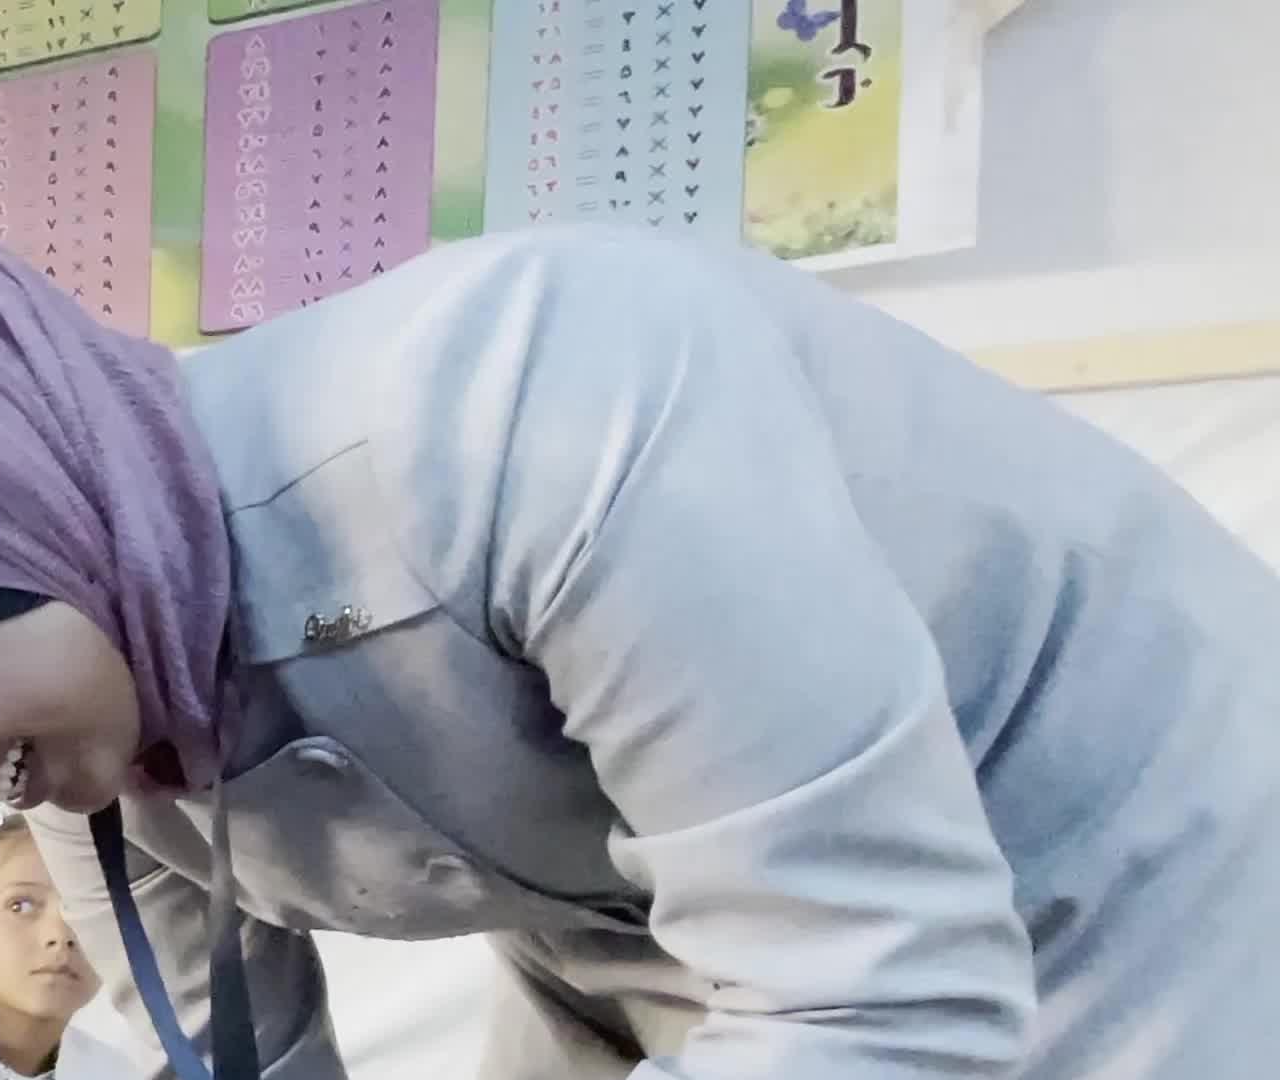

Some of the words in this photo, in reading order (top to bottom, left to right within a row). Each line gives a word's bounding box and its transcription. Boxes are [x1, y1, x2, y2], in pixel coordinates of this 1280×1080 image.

[621, 10, 636, 26] ٣
[690, 24, 707, 39] ٧
[621, 38, 632, 53] ٤
[690, 49, 706, 64] ٧
[619, 64, 632, 80] ٥
[689, 77, 704, 91] ٧
[617, 90, 632, 105] ٦
[688, 104, 704, 119] ٧
[615, 117, 632, 131] ٧
[687, 130, 702, 144] ٧
[615, 144, 630, 158] ٨
[684, 157, 701, 172] ٧
[614, 169, 628, 184] ٩
[684, 184, 700, 199] ٧
[608, 198, 632, 210] ١٠
[682, 210, 698, 225] ٧
